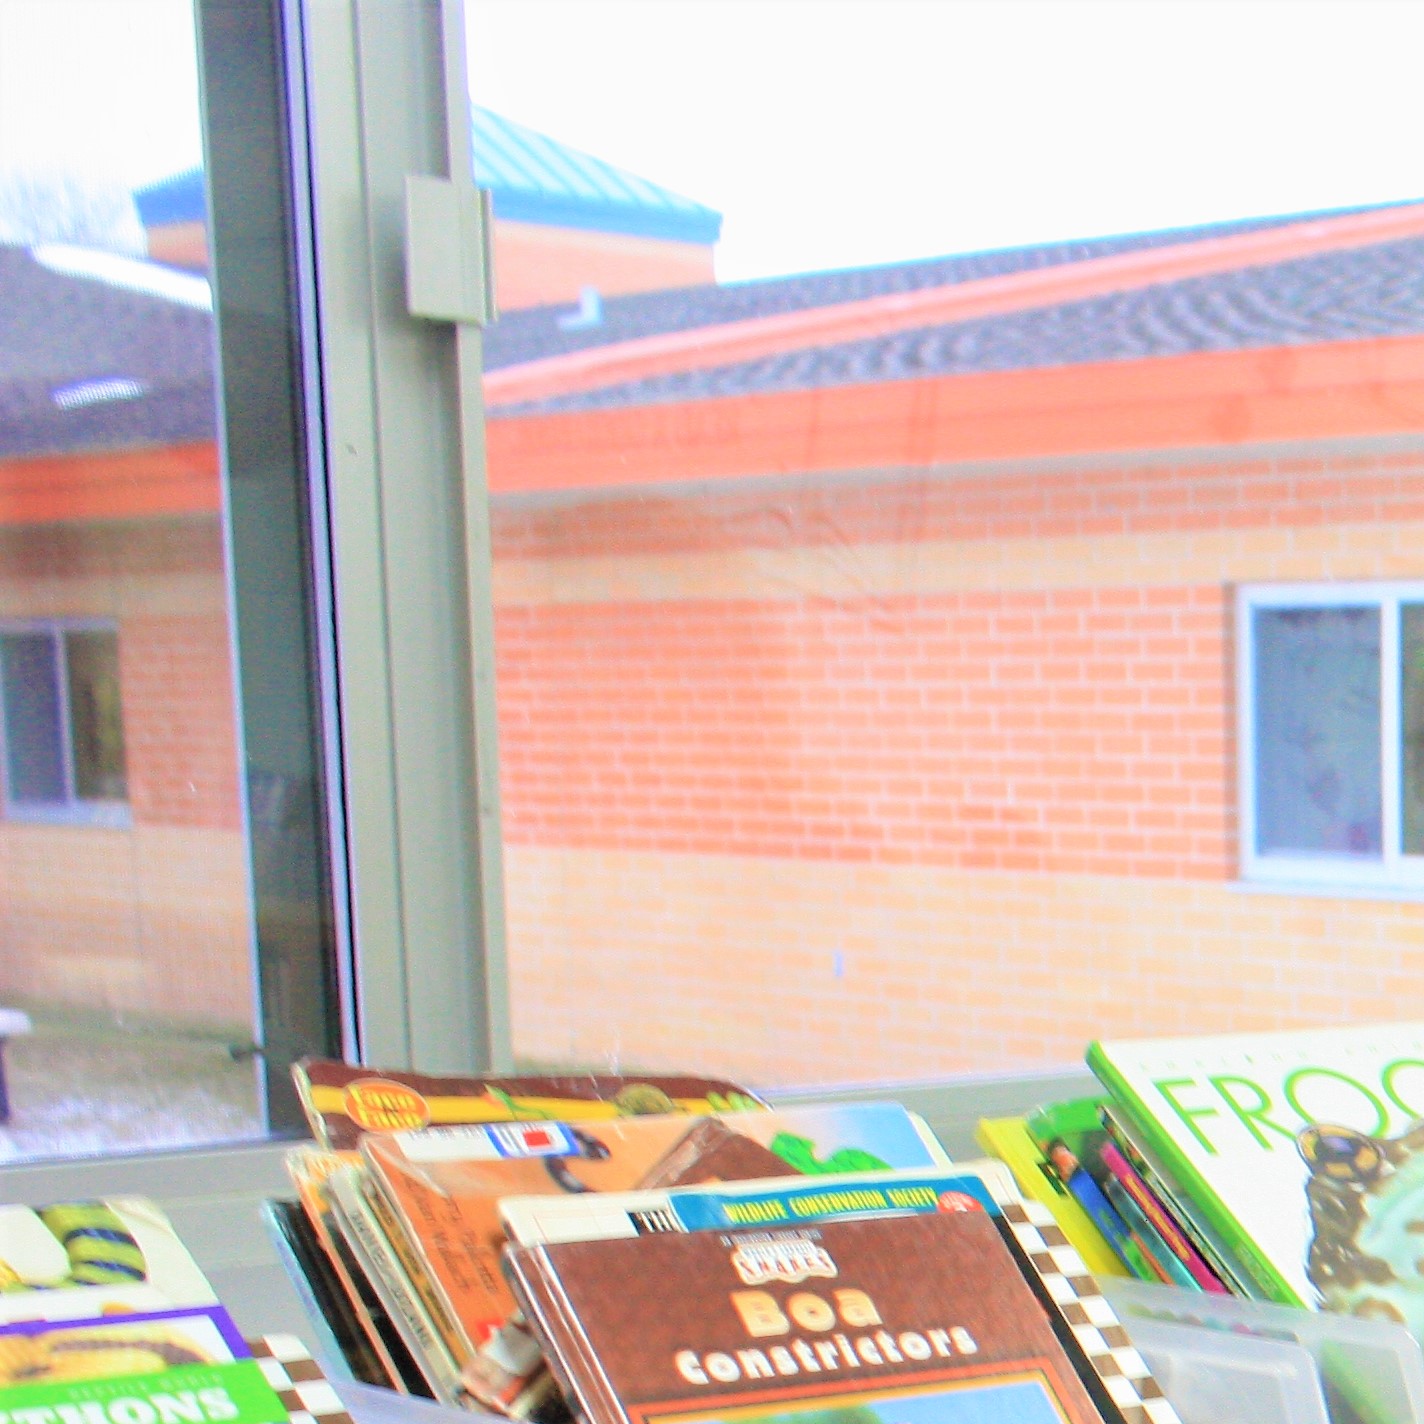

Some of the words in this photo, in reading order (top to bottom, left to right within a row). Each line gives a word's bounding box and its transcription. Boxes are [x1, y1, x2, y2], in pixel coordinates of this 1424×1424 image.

[723, 1199, 788, 1225] WILDLIFE
[788, 1190, 887, 1217] CONSERVATION
[886, 1186, 938, 1208] SOCIETY
[730, 1288, 882, 1338] Boa
[675, 1326, 978, 1385] Constrictors
